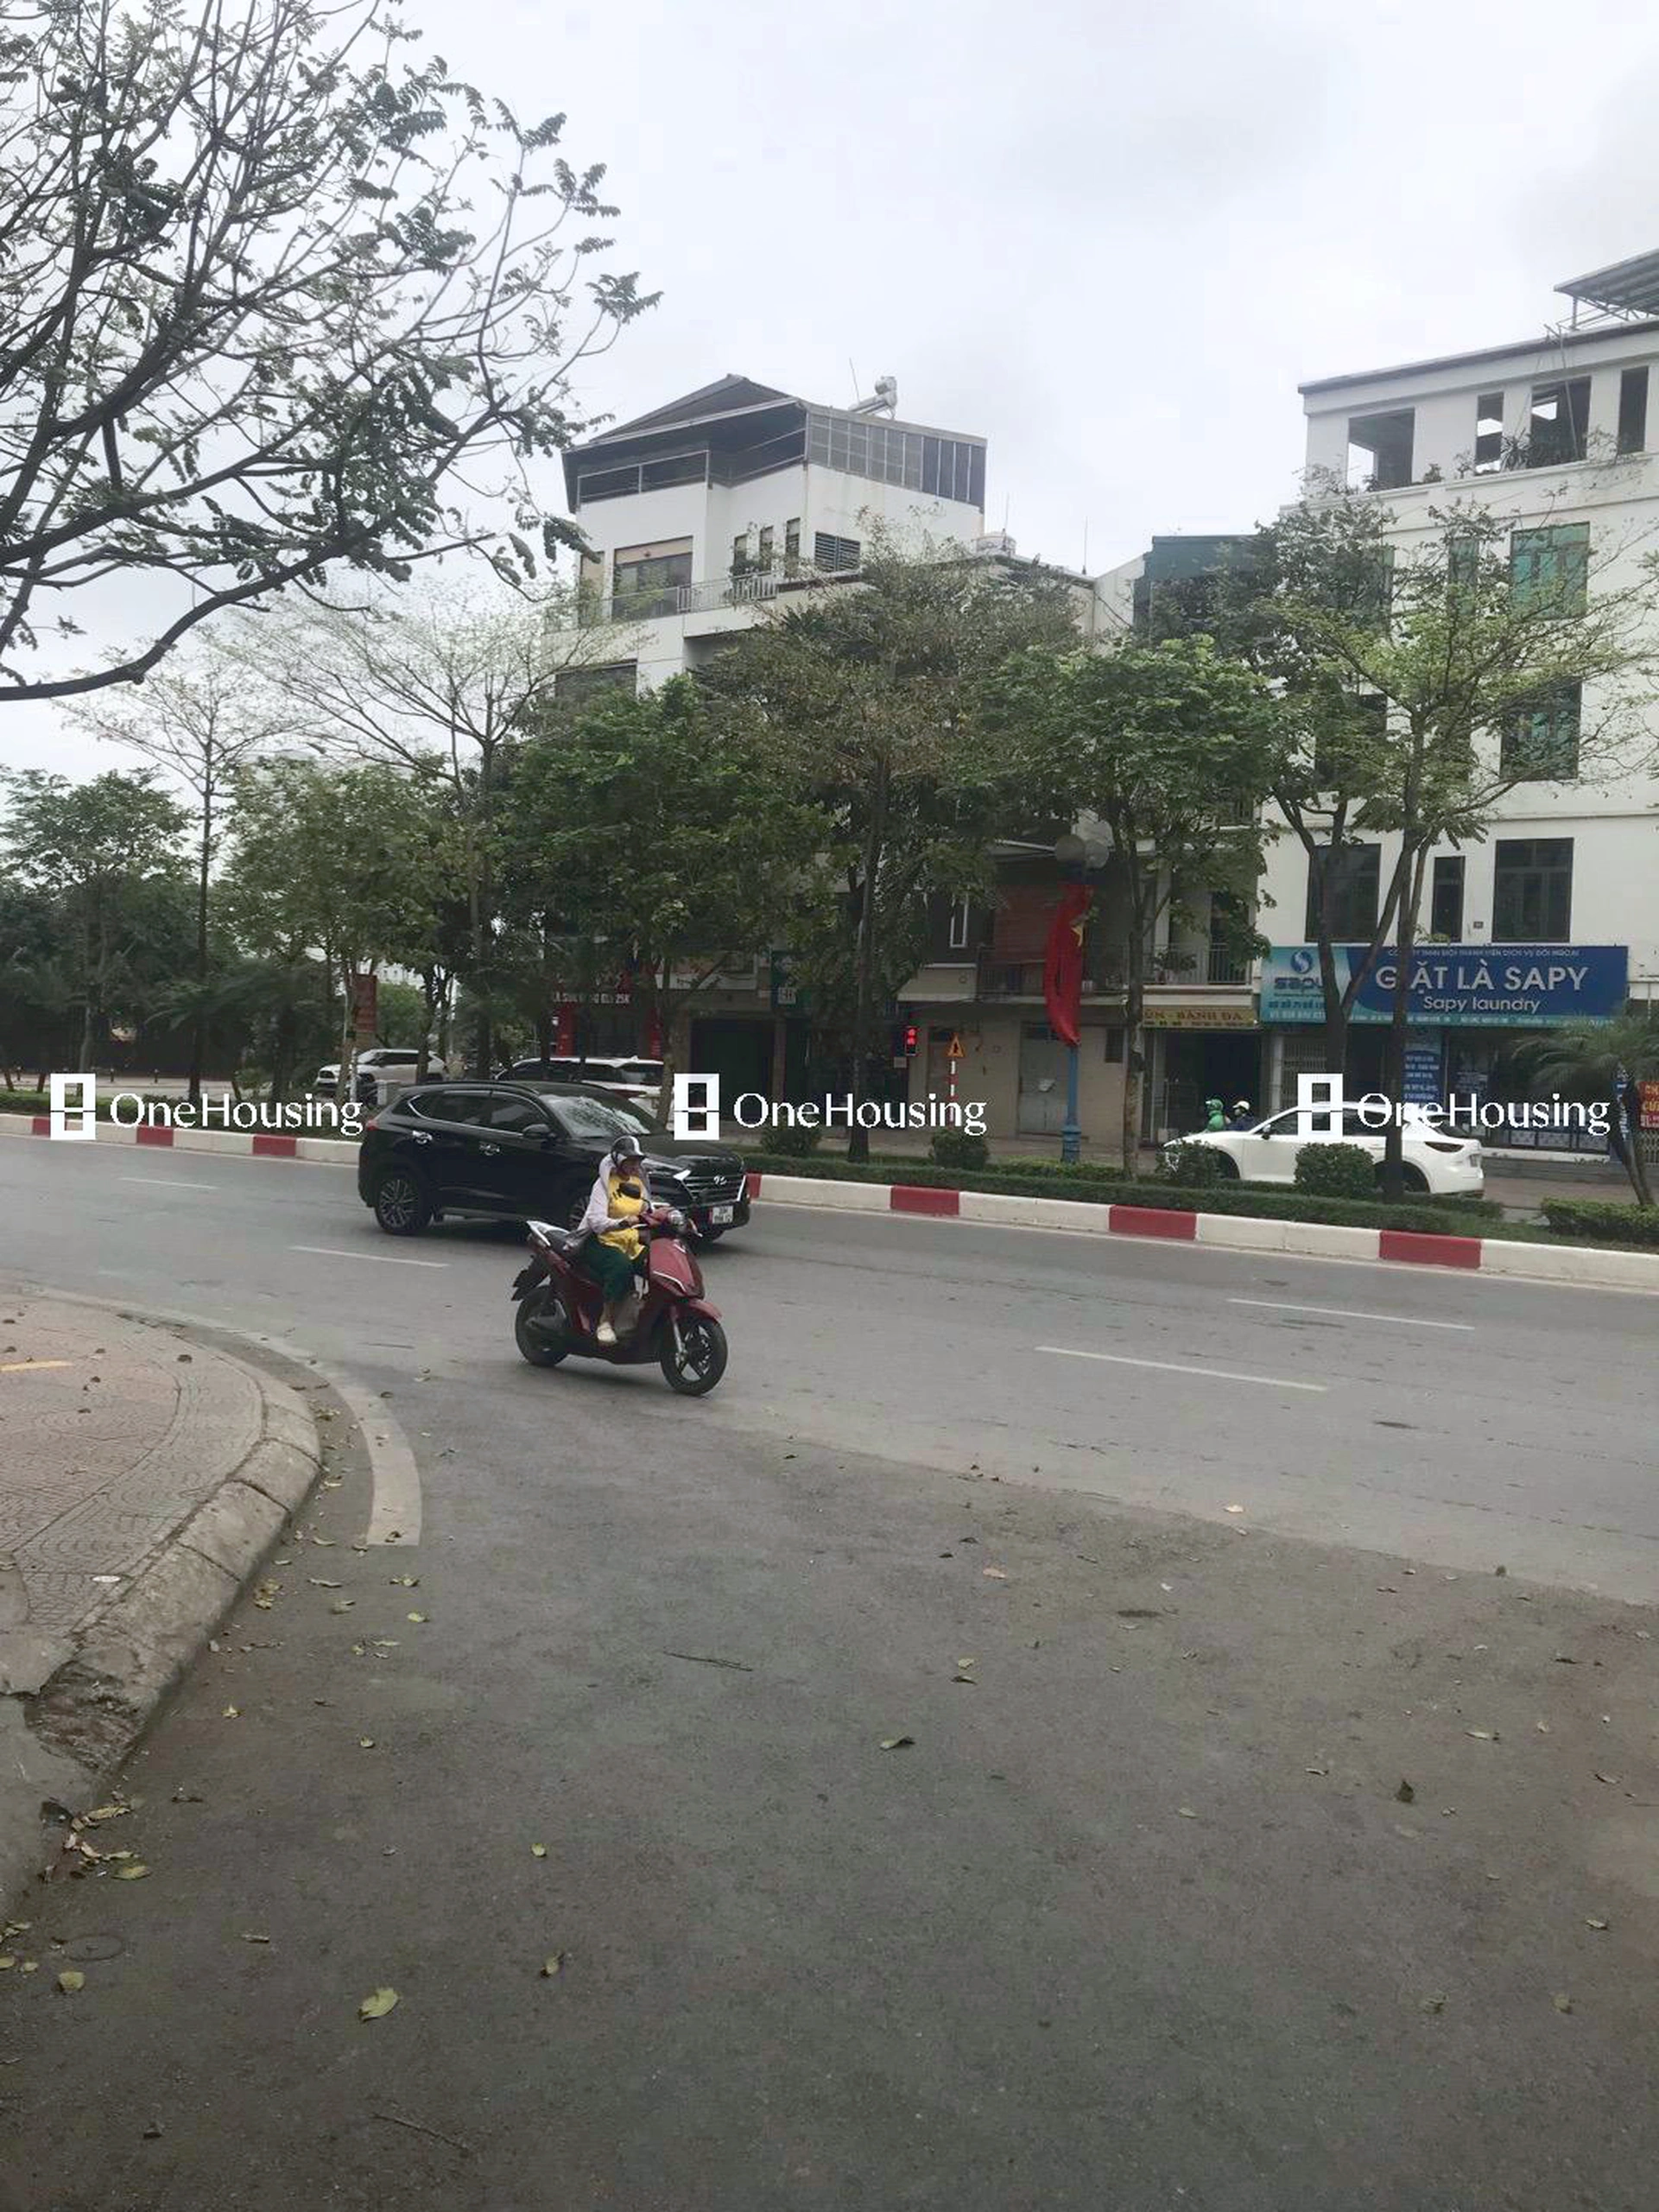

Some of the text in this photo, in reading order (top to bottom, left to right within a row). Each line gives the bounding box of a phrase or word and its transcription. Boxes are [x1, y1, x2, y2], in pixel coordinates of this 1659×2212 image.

[1376, 959, 1588, 993] GẶT LÀ SAPY
[1423, 996, 1541, 1014] Sapy laundry
